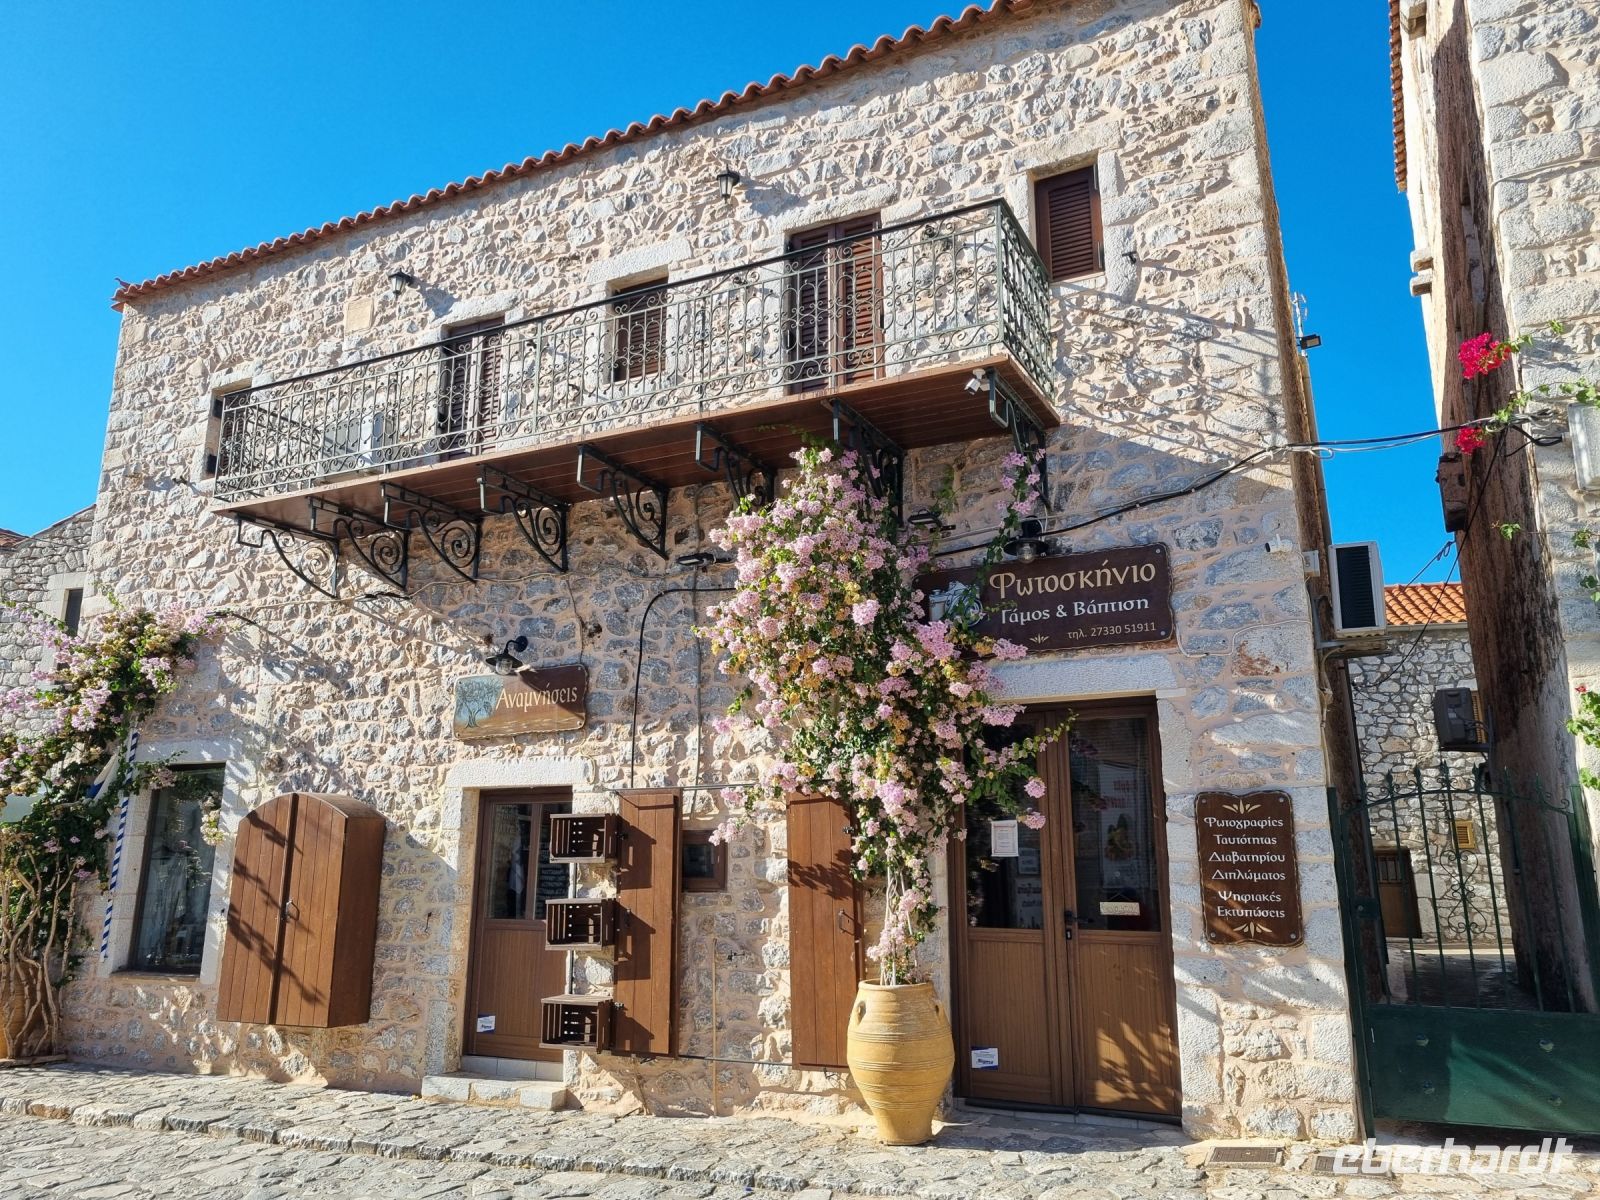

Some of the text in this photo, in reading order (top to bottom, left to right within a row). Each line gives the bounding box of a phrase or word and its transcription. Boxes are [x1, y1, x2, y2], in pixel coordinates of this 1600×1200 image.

[989, 560, 1156, 599] Φωτοσκήνιο
[1001, 598, 1150, 626] Γάμος & Βάπτιση
[1067, 622, 1156, 640] τηλ. 27330 51911
[495, 683, 578, 712] Αναμνήσεις
[1204, 817, 1284, 829] Φωτογραφίες
[1213, 834, 1277, 845] Ταυτότητας
[1208, 851, 1286, 864] Διαβατηρίου
[1211, 869, 1286, 882] Διπλώματος
[1218, 890, 1281, 903] Ψηφιακές
[1217, 906, 1285, 918] Εκτυπώσεις
